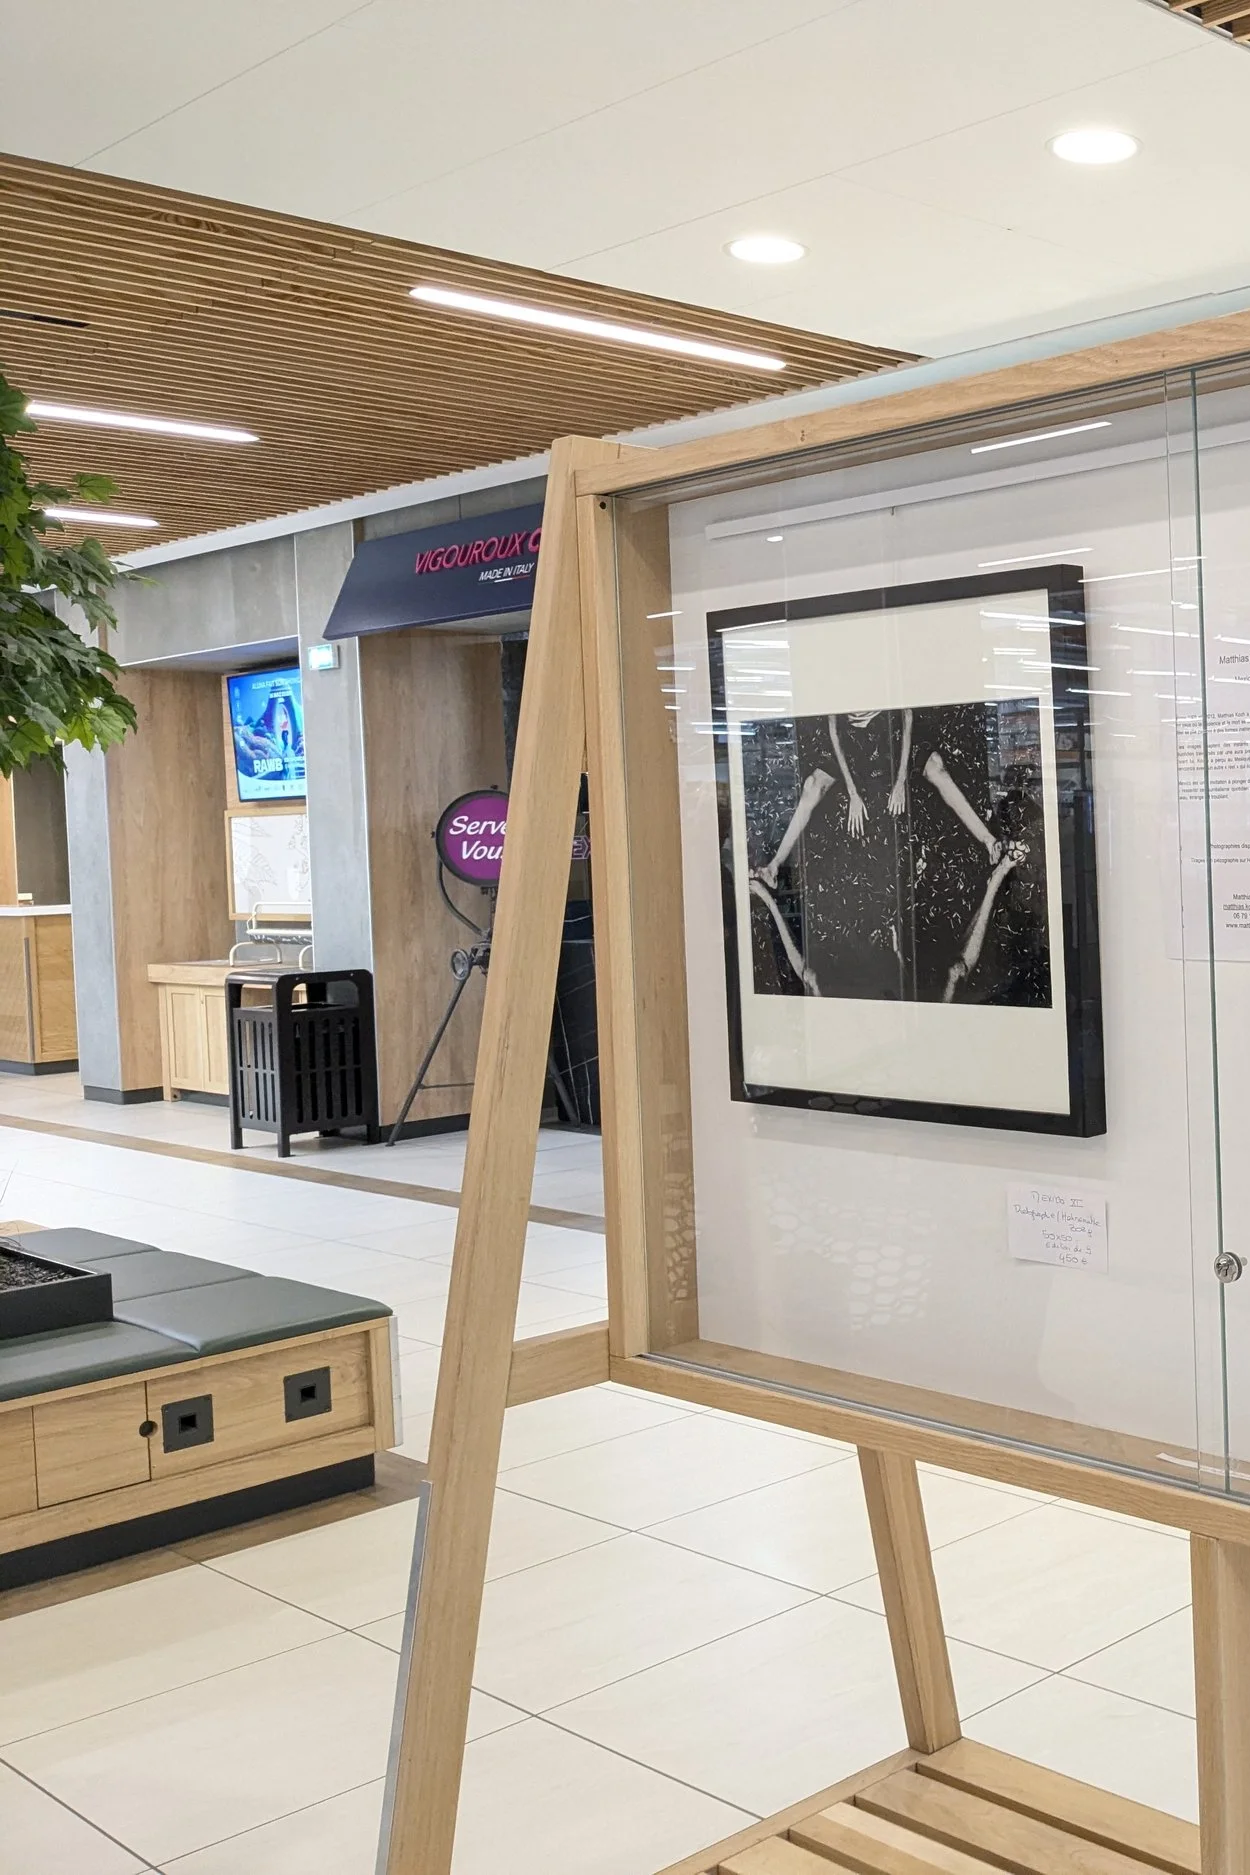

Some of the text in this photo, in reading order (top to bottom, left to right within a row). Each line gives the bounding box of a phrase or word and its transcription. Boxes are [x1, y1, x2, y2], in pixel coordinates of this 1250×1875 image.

[415, 531, 527, 574] VIGOUROUX
[479, 562, 535, 581] MADE IN ITALY
[1219, 655, 1249, 664] Matthias
[253, 757, 284, 774] RAWB
[461, 841, 504, 860] Vou
